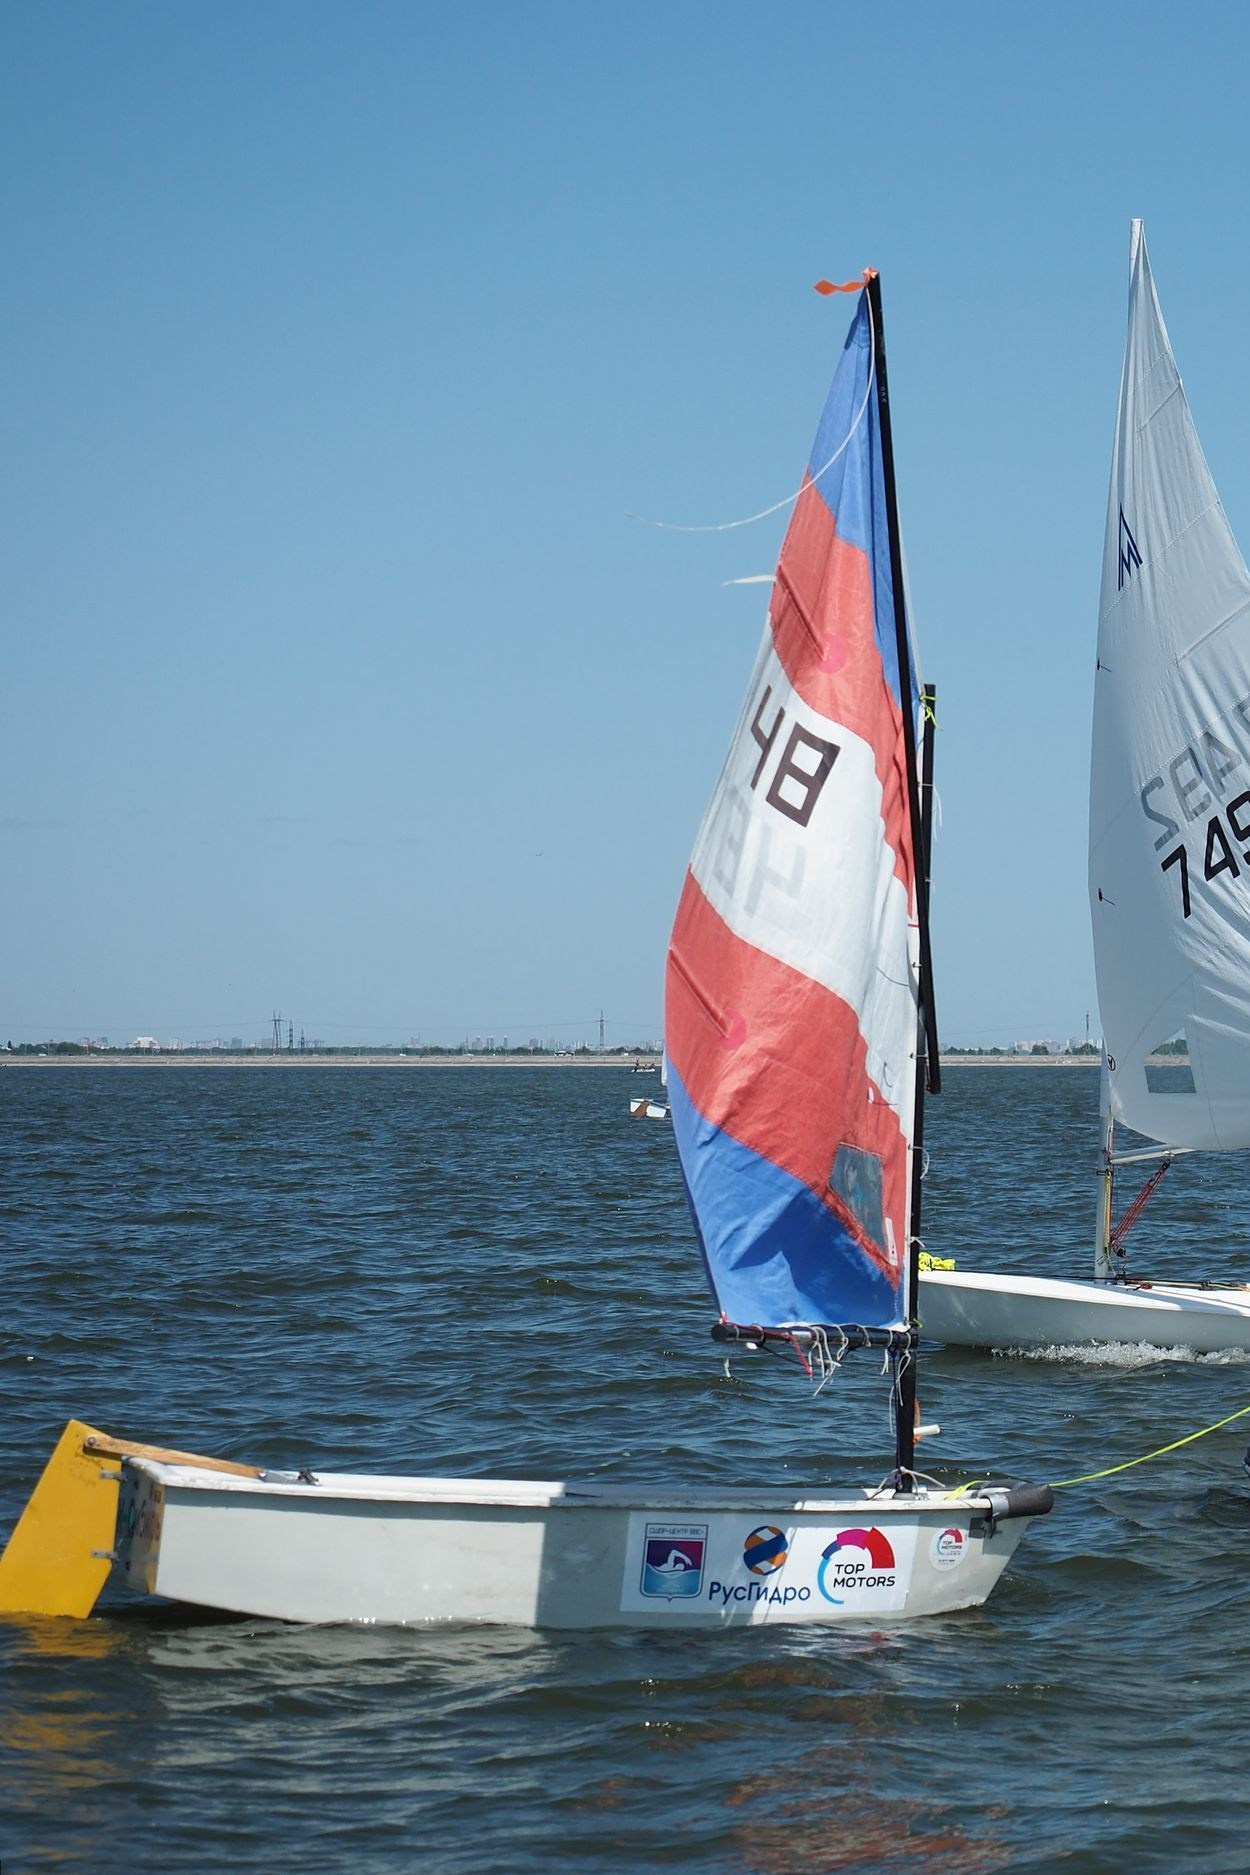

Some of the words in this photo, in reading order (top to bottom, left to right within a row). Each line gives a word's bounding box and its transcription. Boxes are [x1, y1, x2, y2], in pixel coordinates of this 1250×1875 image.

[750, 684, 841, 828] 48
[834, 1563, 865, 1575] TOP
[833, 1575, 896, 1588] MOTORS
[708, 1580, 812, 1606] РусГидро
